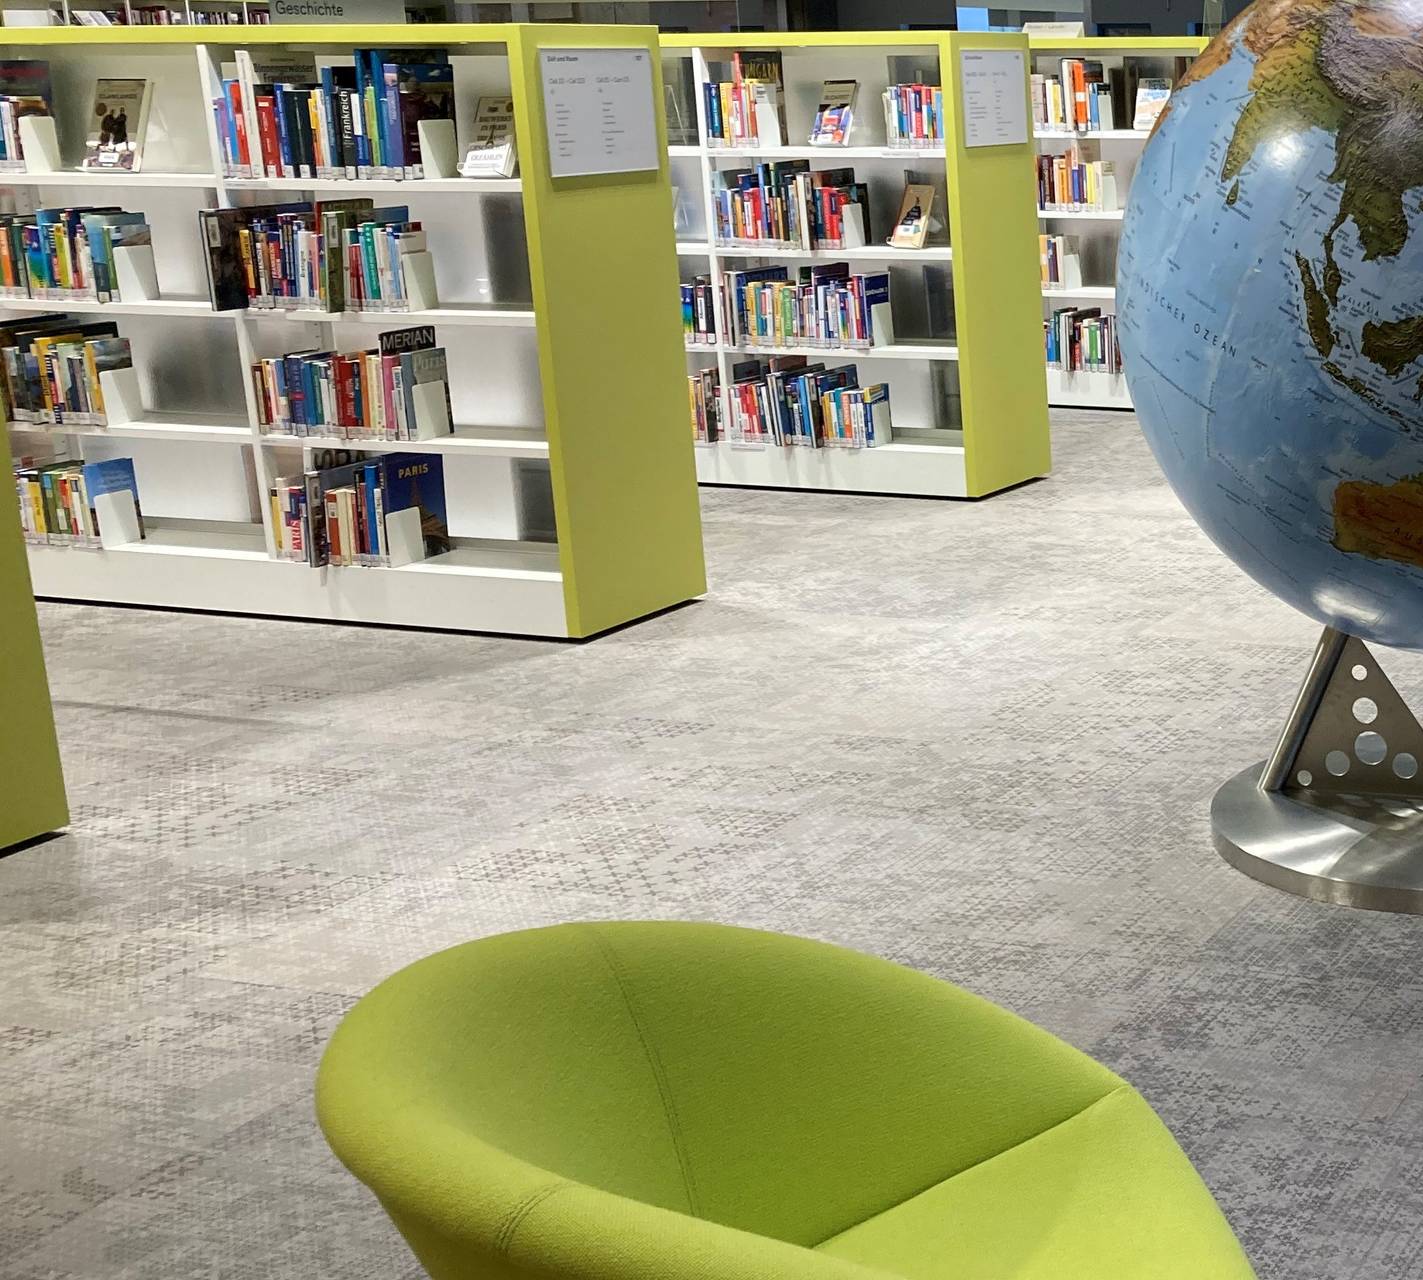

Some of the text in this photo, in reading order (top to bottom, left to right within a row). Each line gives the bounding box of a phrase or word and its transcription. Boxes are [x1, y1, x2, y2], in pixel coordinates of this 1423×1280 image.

[275, 0, 344, 17] Geschichte
[339, 90, 352, 139] Frankreich
[382, 328, 434, 351] MERIAN
[1193, 322, 1237, 358] OZEAN
[398, 463, 430, 479] PARIS
[291, 518, 303, 551] PARIS
